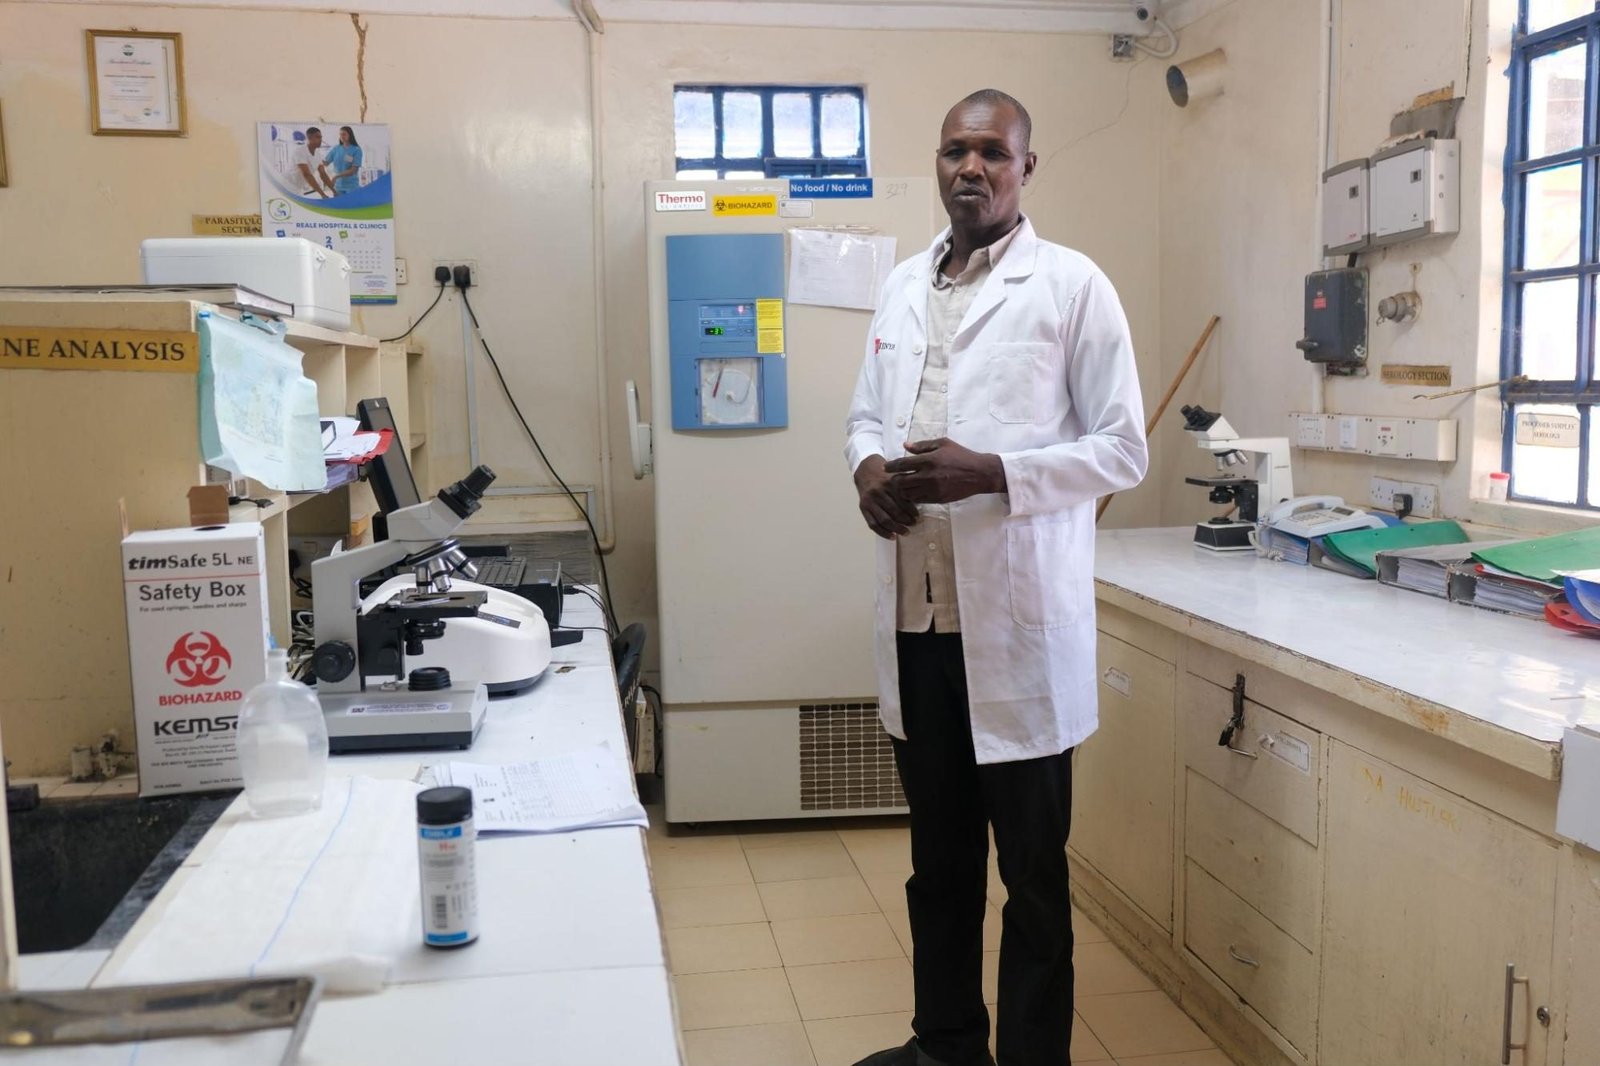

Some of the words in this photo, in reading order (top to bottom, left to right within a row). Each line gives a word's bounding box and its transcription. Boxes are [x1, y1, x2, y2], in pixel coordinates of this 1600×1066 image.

[790, 184, 803, 192] No
[804, 183, 825, 192] food
[831, 184, 844, 192] No
[845, 183, 868, 192] drink
[657, 193, 704, 204] Thermo
[727, 201, 773, 210] BIOHAZARD
[221, 225, 261, 234] SECTION
[48, 338, 186, 362] ANALYSIS
[127, 552, 208, 570] timSafe
[212, 552, 233, 566] 5L
[238, 556, 254, 565] NE
[139, 582, 202, 603] Safety
[210, 581, 246, 598] Box
[158, 690, 243, 707] BIOHAZARD
